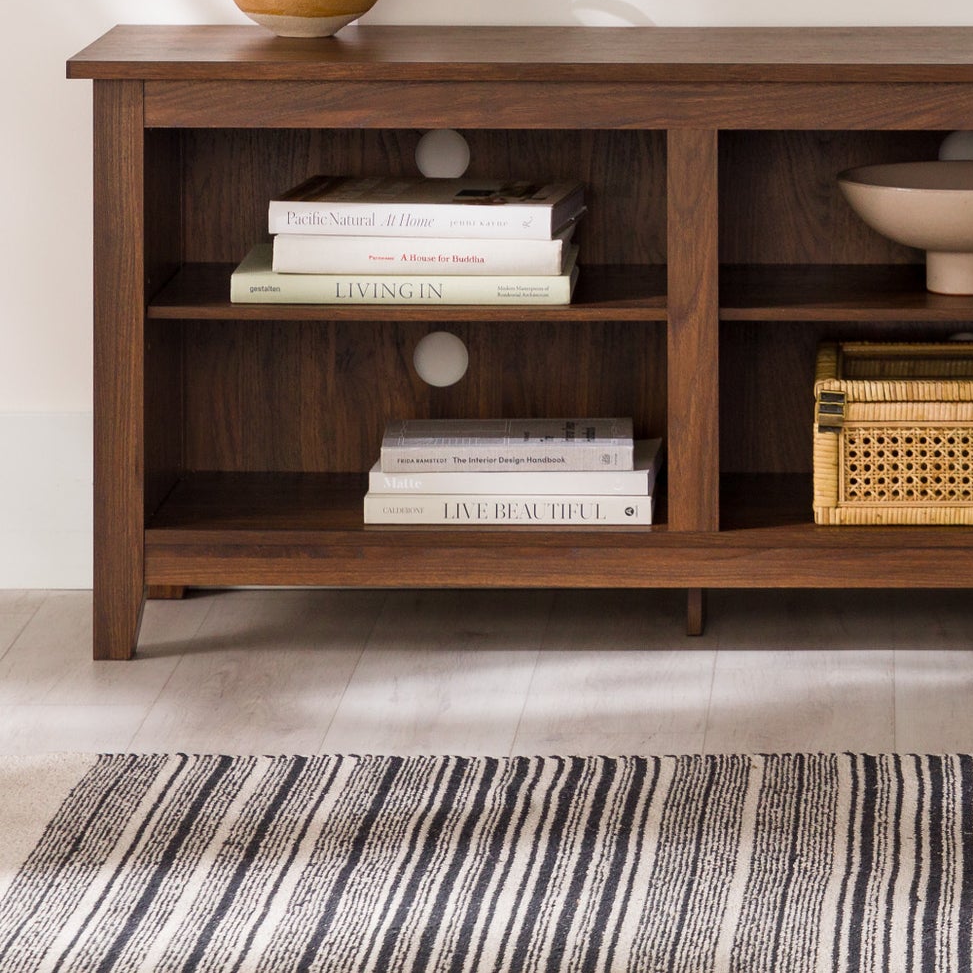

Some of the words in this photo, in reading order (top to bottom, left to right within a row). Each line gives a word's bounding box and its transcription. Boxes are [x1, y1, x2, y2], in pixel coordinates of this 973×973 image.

[287, 211, 327, 226] Pacific
[329, 212, 375, 226] Natural
[380, 213, 396, 227] At
[399, 213, 435, 227] Home
[400, 254, 408, 262] A
[409, 254, 436, 262] House
[437, 254, 450, 262] for
[452, 255, 485, 264] Buddha
[249, 285, 281, 294] gestalten
[335, 282, 413, 299] LIVING
[419, 283, 443, 299] IN
[468, 456, 497, 464] Interior
[498, 456, 525, 465] Design
[526, 456, 566, 464] Handbook
[383, 477, 422, 489] Matte
[443, 502, 488, 520] LIVE
[495, 502, 607, 520] BEAUTIFUL
